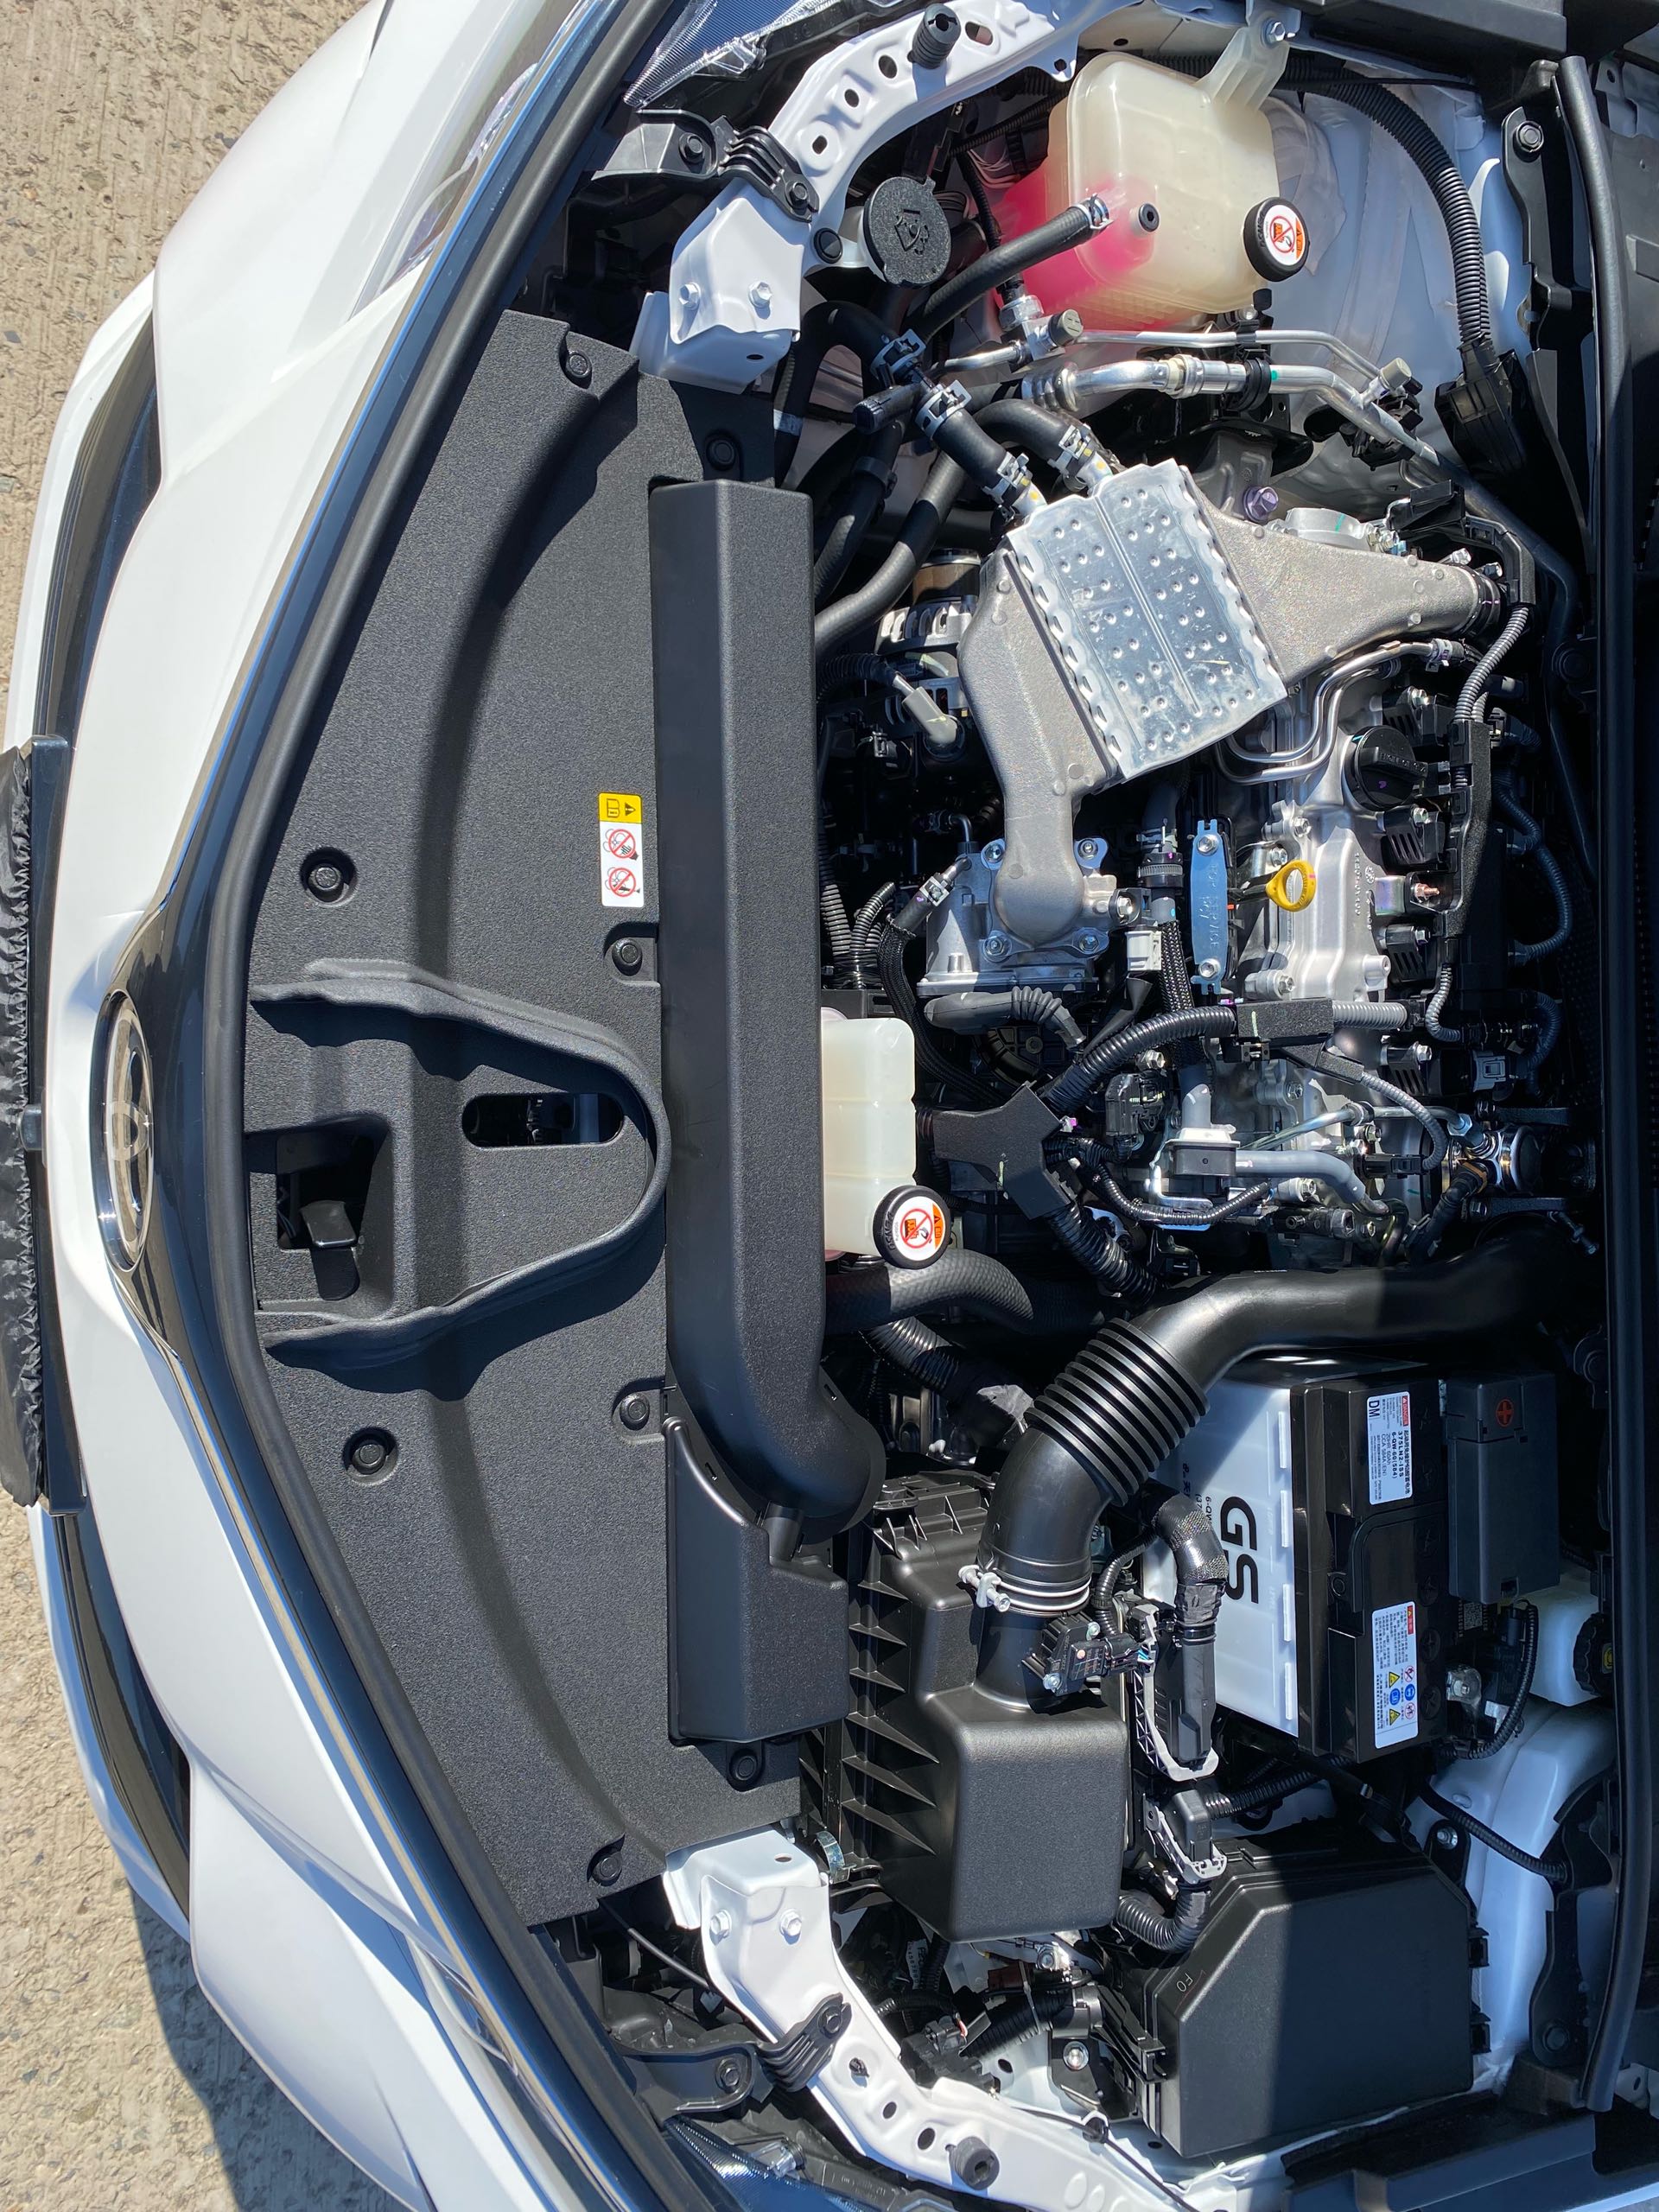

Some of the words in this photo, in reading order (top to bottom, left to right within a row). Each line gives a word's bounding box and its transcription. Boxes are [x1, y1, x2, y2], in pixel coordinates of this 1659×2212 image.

[885, 1211, 895, 1250] DENSO
[1369, 1400, 1381, 1417] DM
[1220, 1496, 1259, 1605] GS
